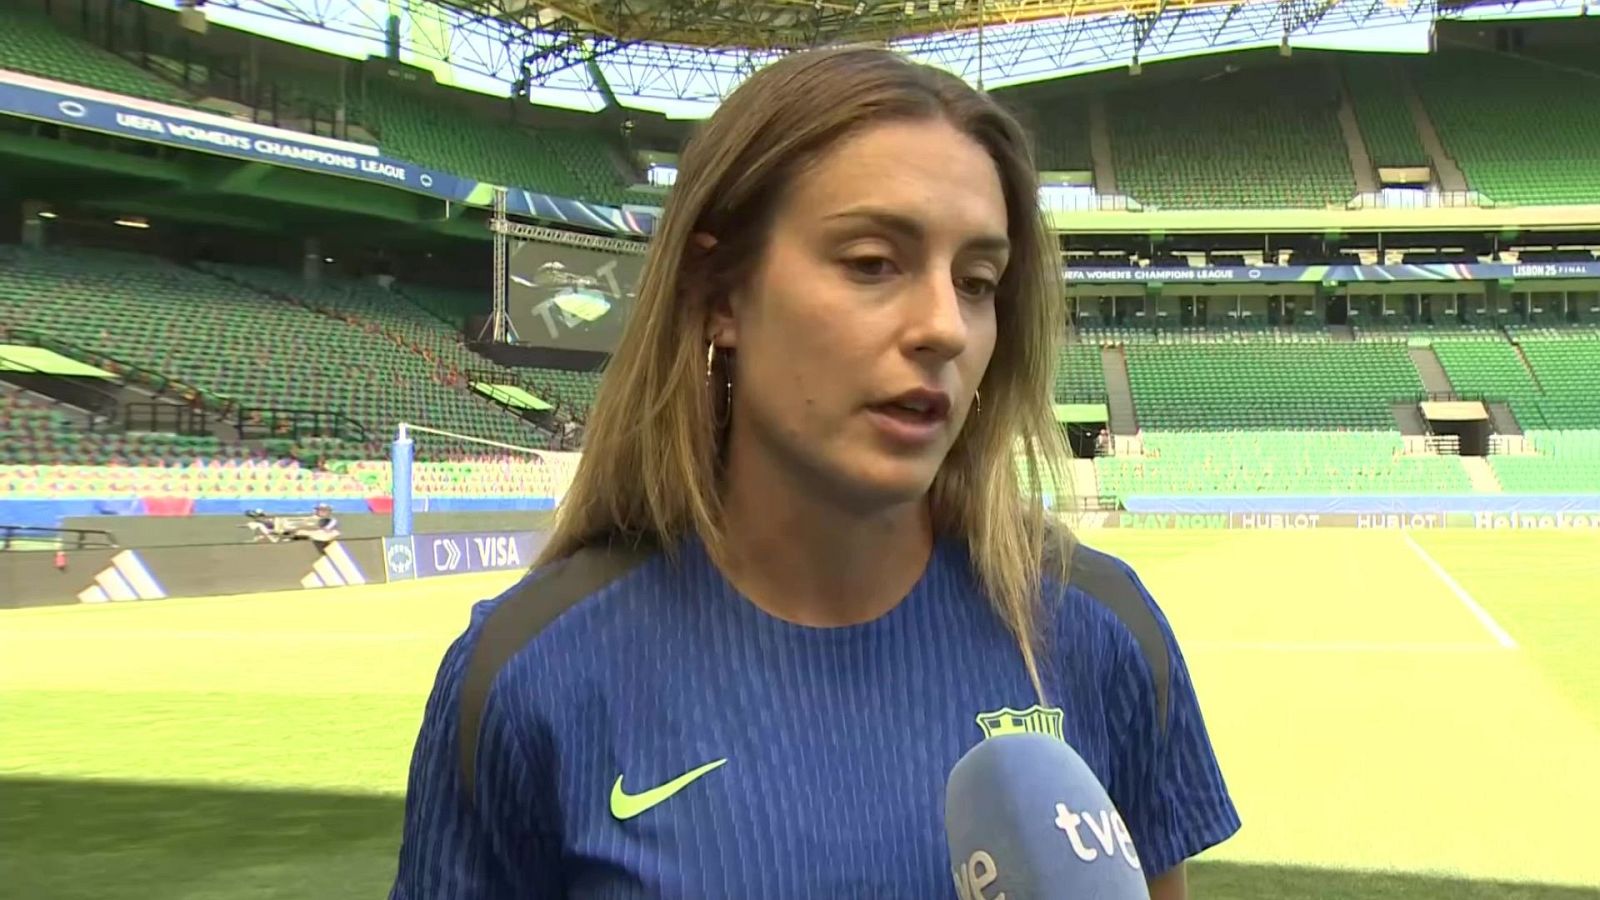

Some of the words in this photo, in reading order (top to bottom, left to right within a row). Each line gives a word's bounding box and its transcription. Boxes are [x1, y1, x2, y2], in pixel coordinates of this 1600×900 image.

[116, 112, 165, 134] UEFA
[254, 140, 358, 169] CHAMPIONS
[361, 159, 406, 180] LEAGUE
[1134, 270, 1194, 280] CHAMPIONS
[1197, 269, 1234, 279] LEAGUE
[1513, 265, 1544, 276] LISBON
[1545, 265, 1557, 276] 25
[1120, 513, 1168, 528] PLAY
[1175, 513, 1226, 528] NOW
[1242, 513, 1320, 528] HUBLOT
[1357, 513, 1437, 528] HUBLOT
[474, 537, 520, 567] VISA
[1055, 803, 1141, 869] tve
[955, 850, 1006, 900] ve
